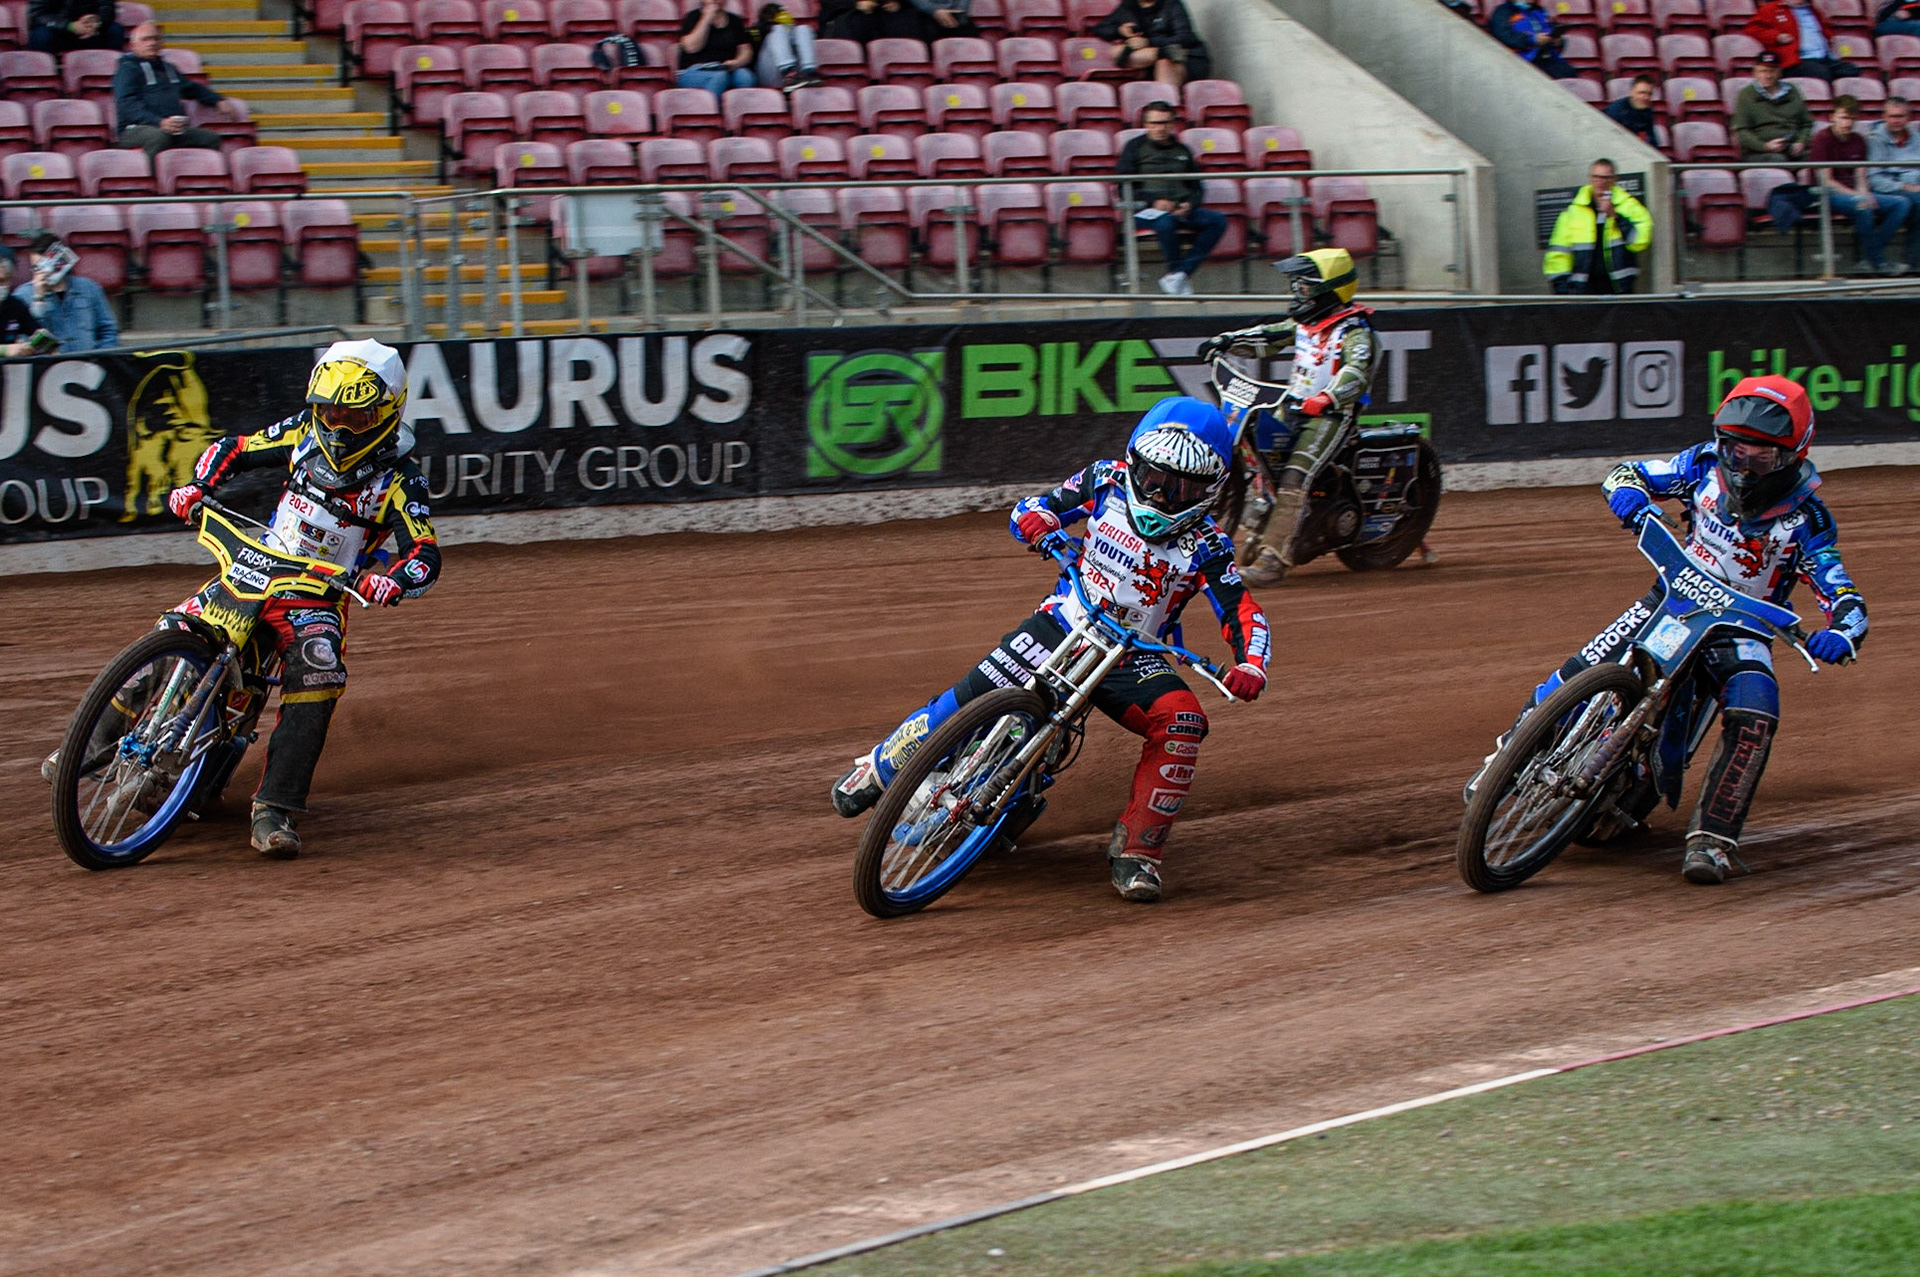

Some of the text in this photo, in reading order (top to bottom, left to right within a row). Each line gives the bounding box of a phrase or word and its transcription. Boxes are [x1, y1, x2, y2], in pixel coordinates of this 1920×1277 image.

[313, 334, 752, 434] AURUS
[413, 440, 751, 500] URITY GROUP
[289, 494, 315, 517] 2021
[1094, 536, 1135, 569] YOUTH
[1097, 521, 1143, 554] BRITISH
[1180, 536, 1196, 552] 33
[237, 546, 278, 572] FRISKY
[232, 566, 266, 586] RACING
[1678, 566, 1736, 608] HAGON
[1671, 577, 1724, 618] SHOCKS
[1586, 608, 1652, 667] SHOCKS
